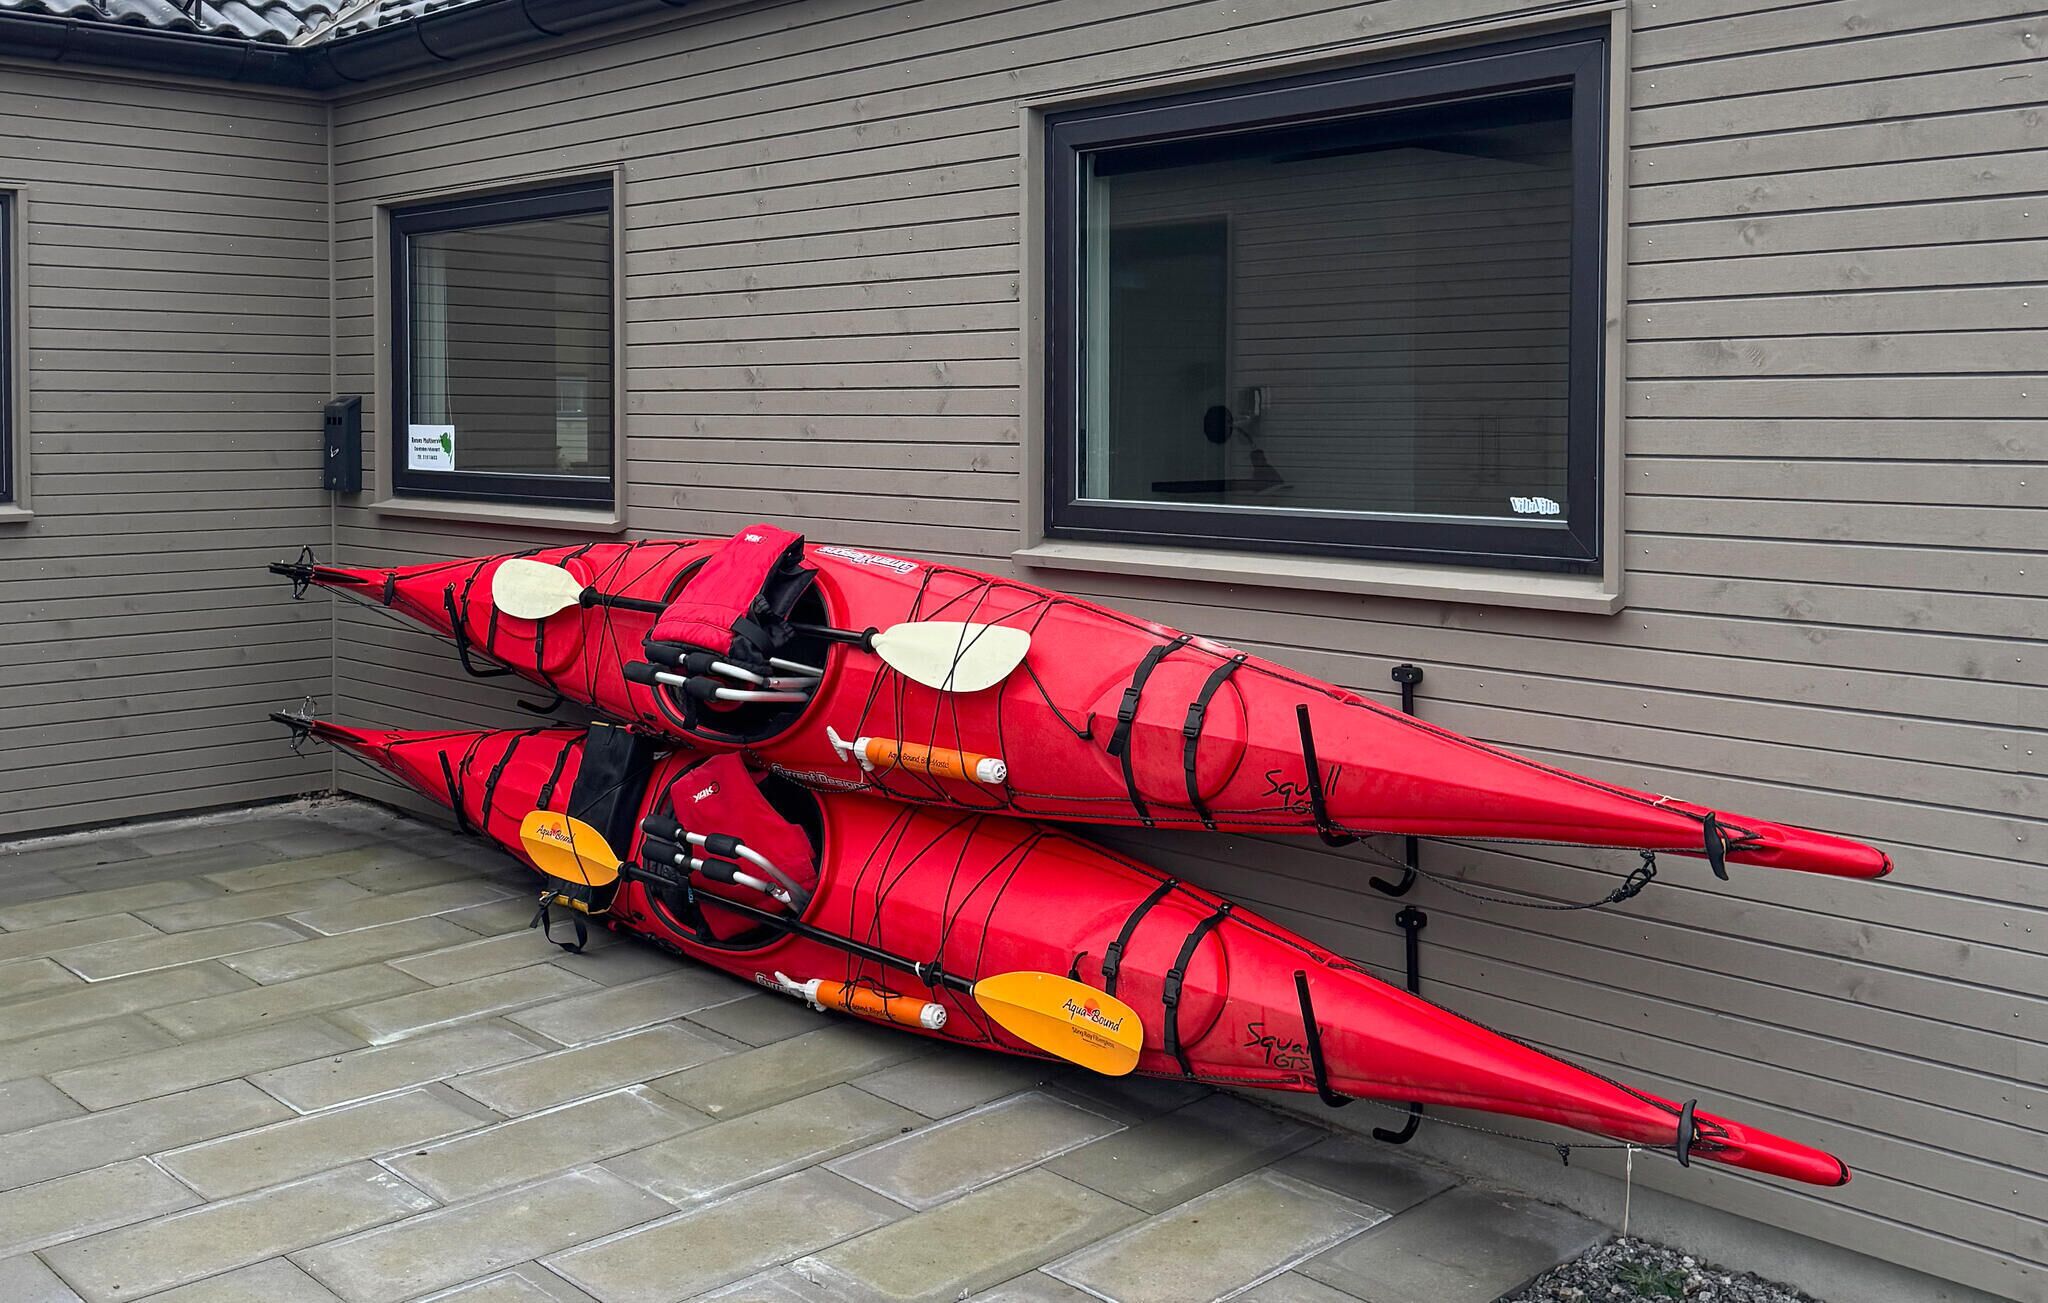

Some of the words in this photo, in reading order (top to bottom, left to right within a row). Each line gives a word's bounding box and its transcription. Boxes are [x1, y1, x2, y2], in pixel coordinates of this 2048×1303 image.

[772, 764, 818, 782] Current
[692, 785, 714, 803] YAK
[1261, 765, 1342, 811] Squll
[1273, 1053, 1310, 1070] GTS
